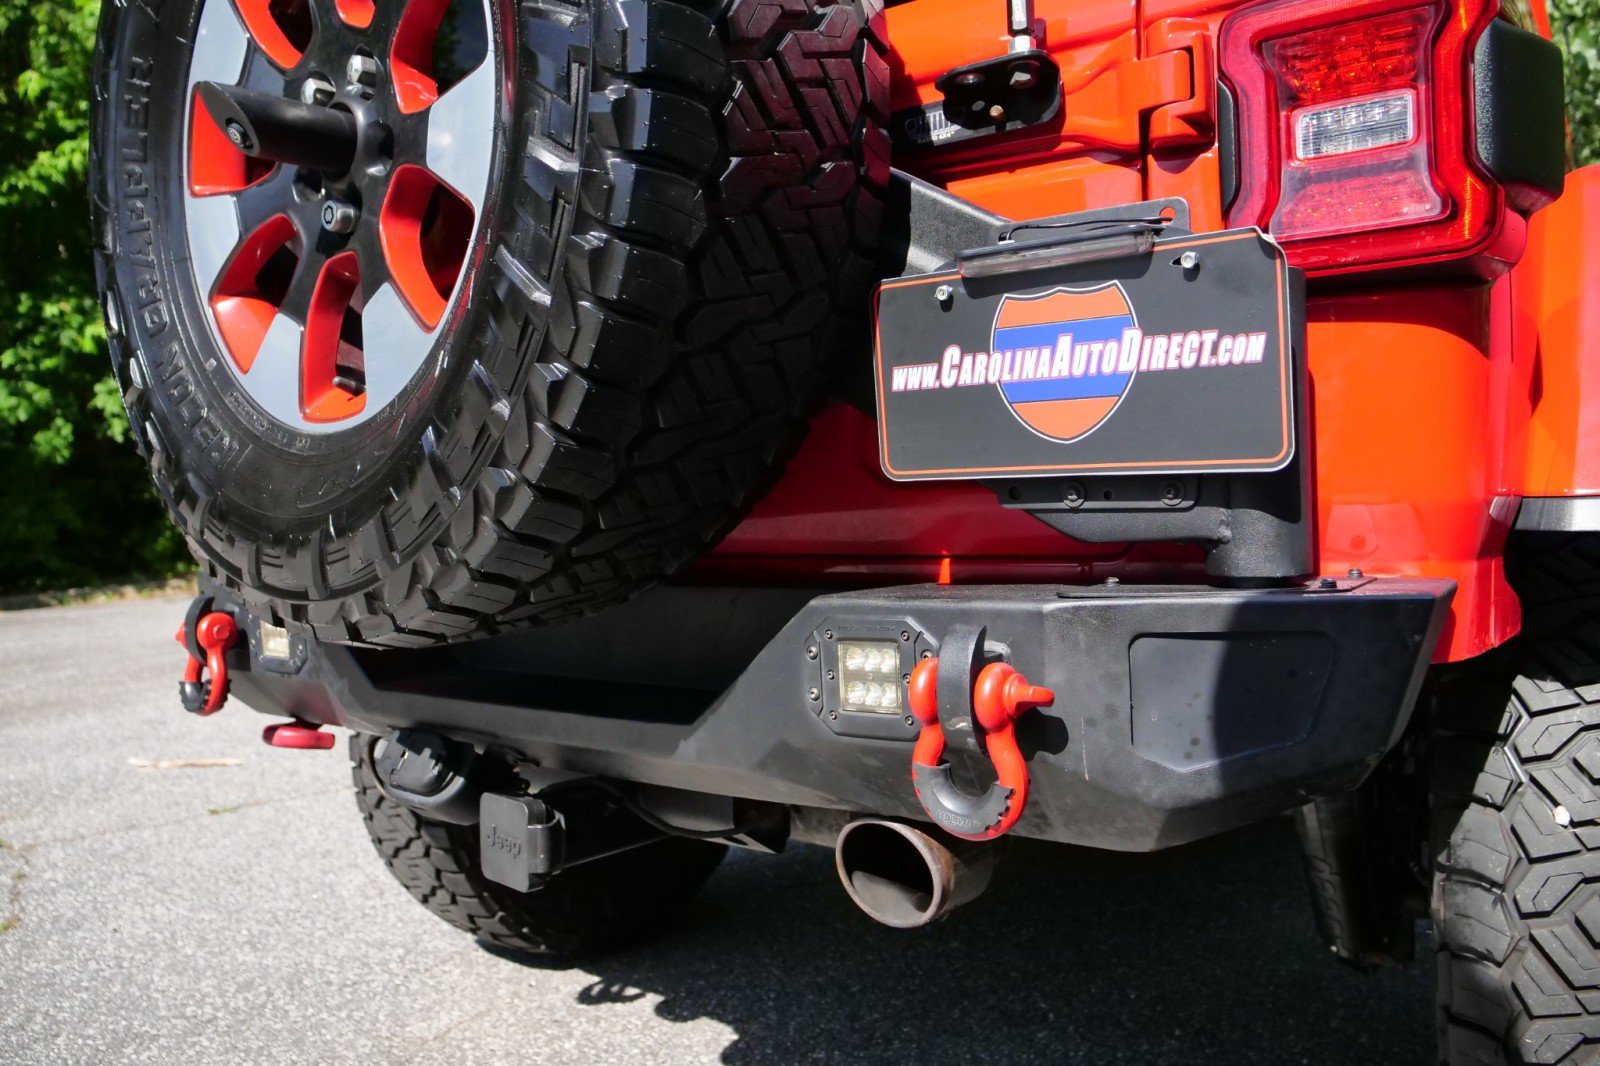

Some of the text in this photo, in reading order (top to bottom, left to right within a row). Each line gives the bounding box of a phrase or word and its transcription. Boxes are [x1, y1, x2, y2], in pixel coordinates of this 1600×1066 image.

[122, 55, 170, 339] GRAPPLER
[891, 327, 1267, 392] WWW.CAROLINAAUTODIRECT.COM
[486, 822, 522, 860] Jeep
